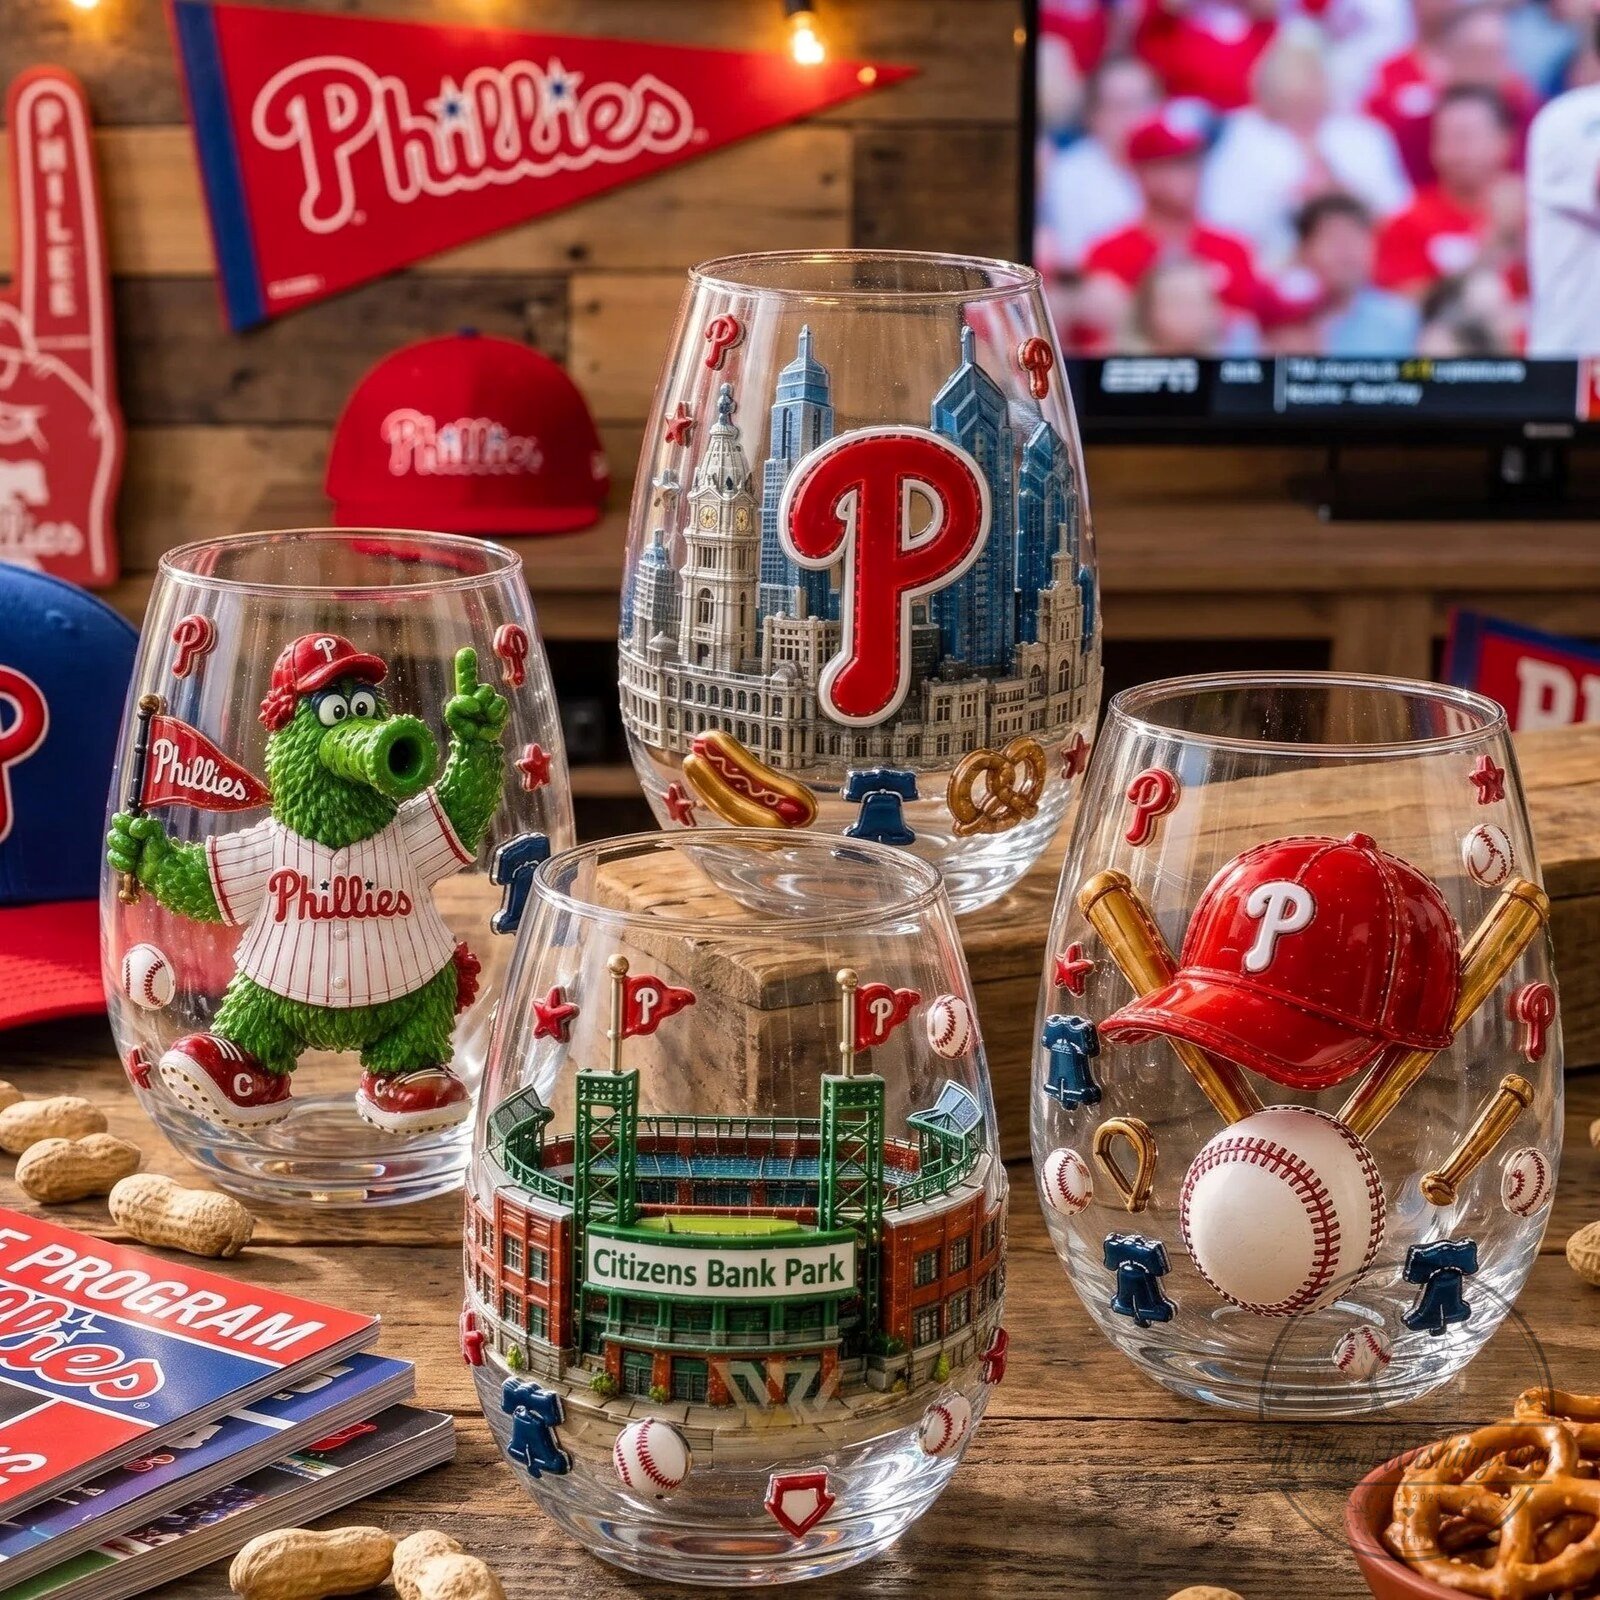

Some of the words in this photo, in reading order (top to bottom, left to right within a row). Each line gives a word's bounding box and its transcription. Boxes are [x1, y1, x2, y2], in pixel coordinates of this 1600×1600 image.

[251, 55, 695, 234] Phillies
[703, 314, 744, 371] P
[380, 408, 544, 476] Phillies
[779, 425, 993, 728] P
[171, 614, 216, 680] P
[314, 637, 337, 662] P
[152, 738, 247, 801] Phillies
[1125, 768, 1181, 847] P
[267, 866, 413, 925] Phillies
[1244, 880, 1316, 973] P
[635, 988, 659, 1025] P
[868, 998, 894, 1036] P
[234, 1073, 252, 1097] C
[5, 1243, 327, 1351] PROGRAM
[593, 1248, 698, 1287] Citizens
[707, 1258, 777, 1288] Bank
[785, 1253, 846, 1287] Park
